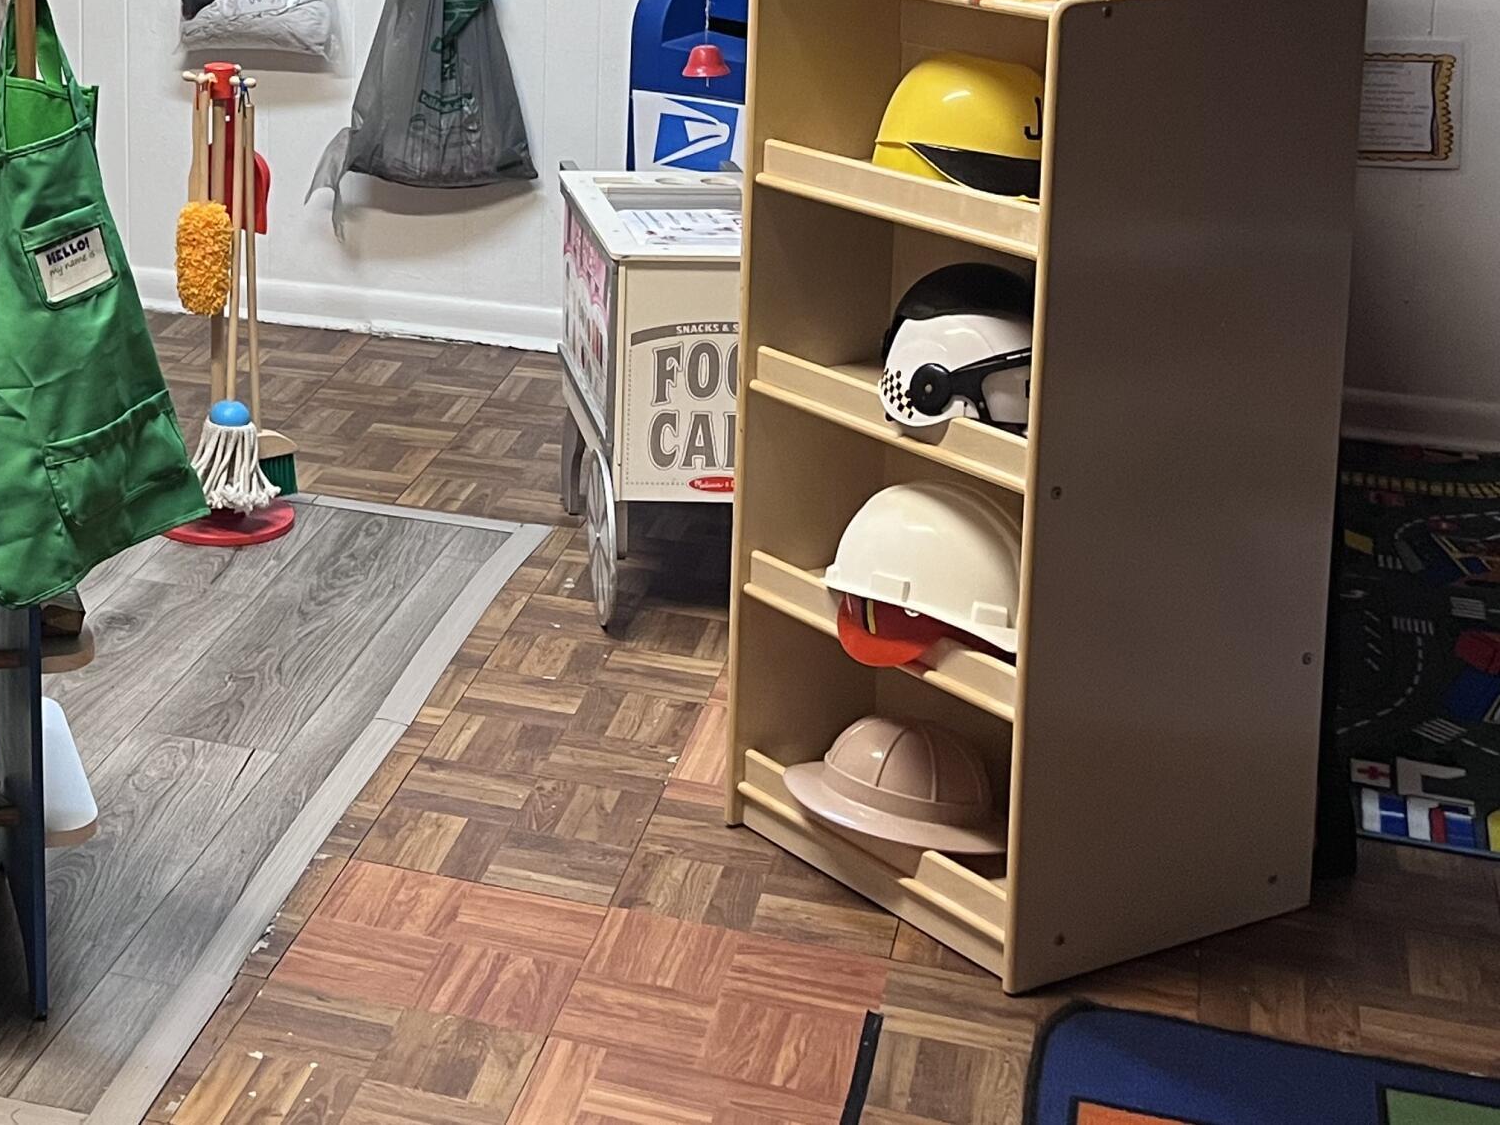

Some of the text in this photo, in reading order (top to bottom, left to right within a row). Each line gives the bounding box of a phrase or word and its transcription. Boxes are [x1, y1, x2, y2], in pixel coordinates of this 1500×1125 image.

[46, 237, 90, 266] HELLO!
[49, 266, 63, 277] my
[65, 255, 87, 270] name
[676, 324, 719, 335] SNACKS
